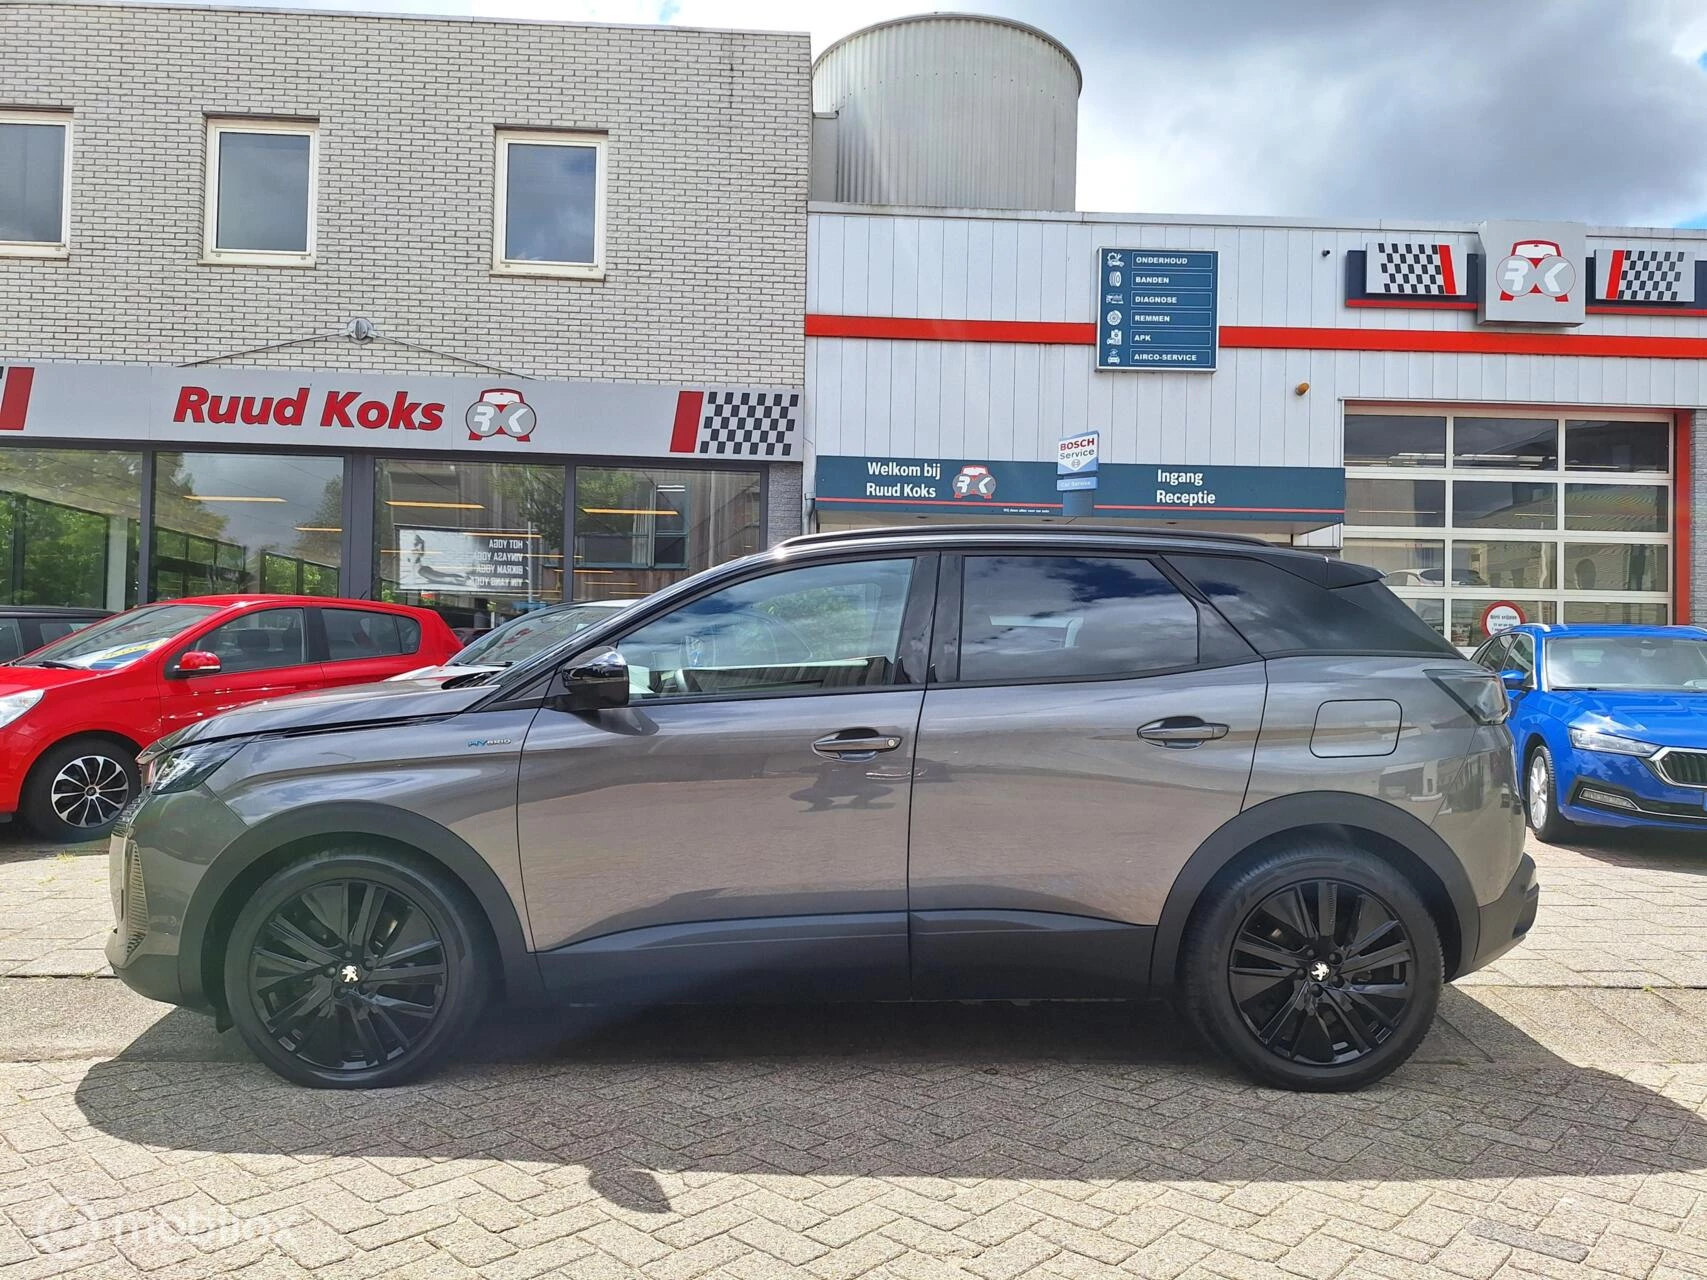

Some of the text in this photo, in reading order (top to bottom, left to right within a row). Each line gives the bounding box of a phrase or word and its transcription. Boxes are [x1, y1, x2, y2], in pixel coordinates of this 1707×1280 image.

[1134, 296, 1178, 304] DIAGNOSE
[1134, 334, 1152, 342] APK
[1133, 353, 1198, 361] AIRCO-SERVICE
[173, 386, 446, 431] Ruud Koks
[1060, 437, 1095, 452] BOSCH
[1060, 449, 1095, 460] Service
[867, 462, 941, 480] Welkom bij
[1157, 469, 1204, 486] Ingang
[866, 482, 937, 498] Ruud Koks
[1156, 489, 1216, 506] Receptie
